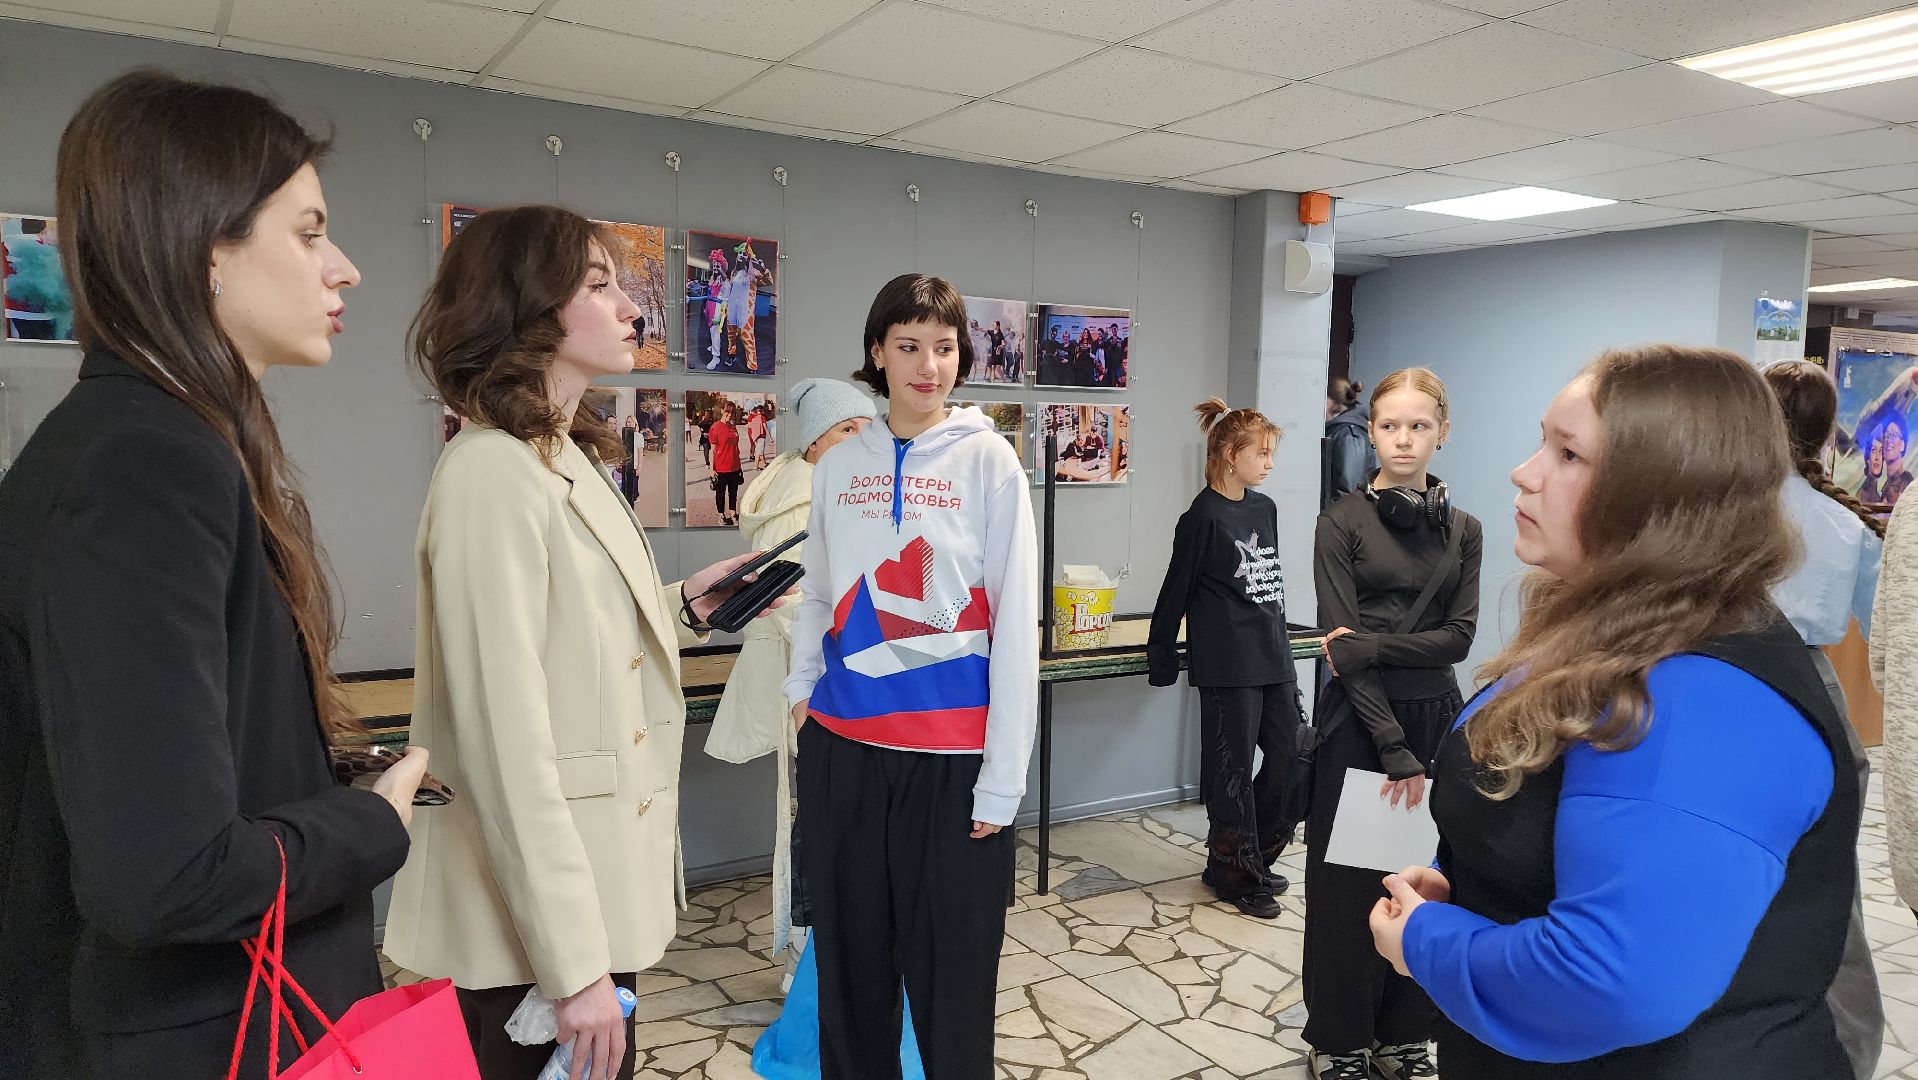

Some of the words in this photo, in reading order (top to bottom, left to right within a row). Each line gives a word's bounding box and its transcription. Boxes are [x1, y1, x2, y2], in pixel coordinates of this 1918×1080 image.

[837, 491, 961, 510] ПОДМОКОВЬЯ
[861, 510, 879, 519] МЫ
[882, 510, 922, 521] РЯОМ
